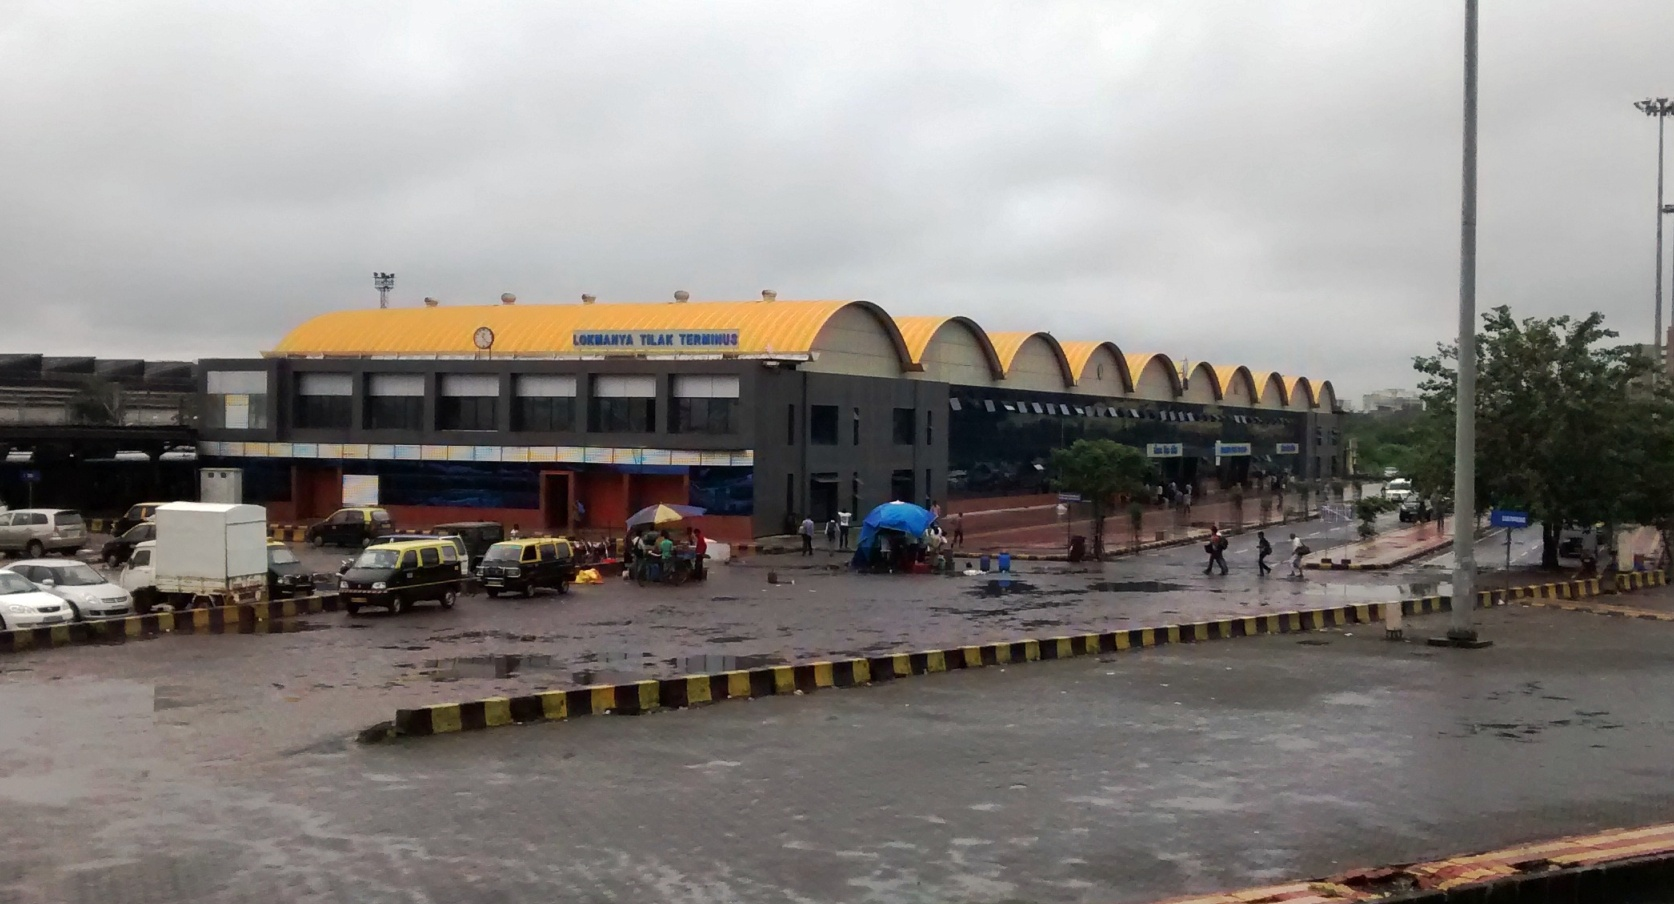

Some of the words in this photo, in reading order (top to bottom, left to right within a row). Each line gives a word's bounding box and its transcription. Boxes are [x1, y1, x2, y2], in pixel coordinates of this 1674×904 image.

[573, 334, 634, 346] LOKMANYA
[640, 334, 674, 346] TILAK
[679, 333, 738, 346] TERMINUS
